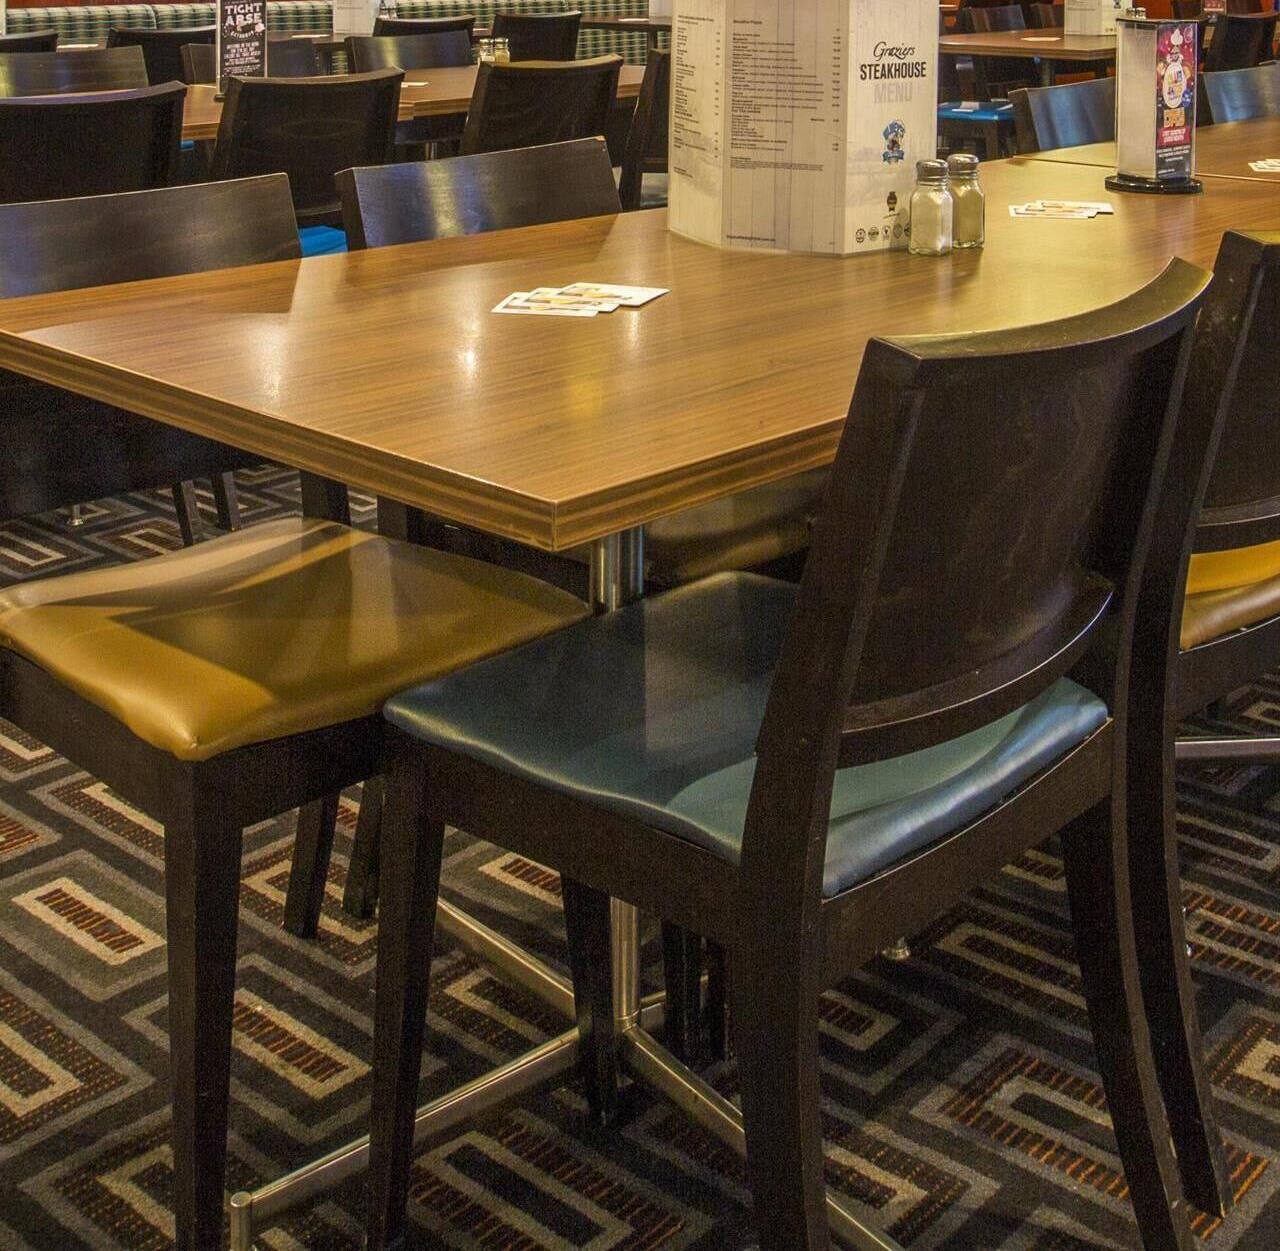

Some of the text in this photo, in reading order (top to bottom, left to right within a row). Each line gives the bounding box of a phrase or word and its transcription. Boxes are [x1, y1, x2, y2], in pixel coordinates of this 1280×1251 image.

[224, 2, 263, 15] TIGHT
[224, 12, 263, 27] ARSE
[872, 40, 917, 62] Graziers
[860, 61, 927, 81] STEAKHOUSE
[873, 82, 913, 104] MENU
